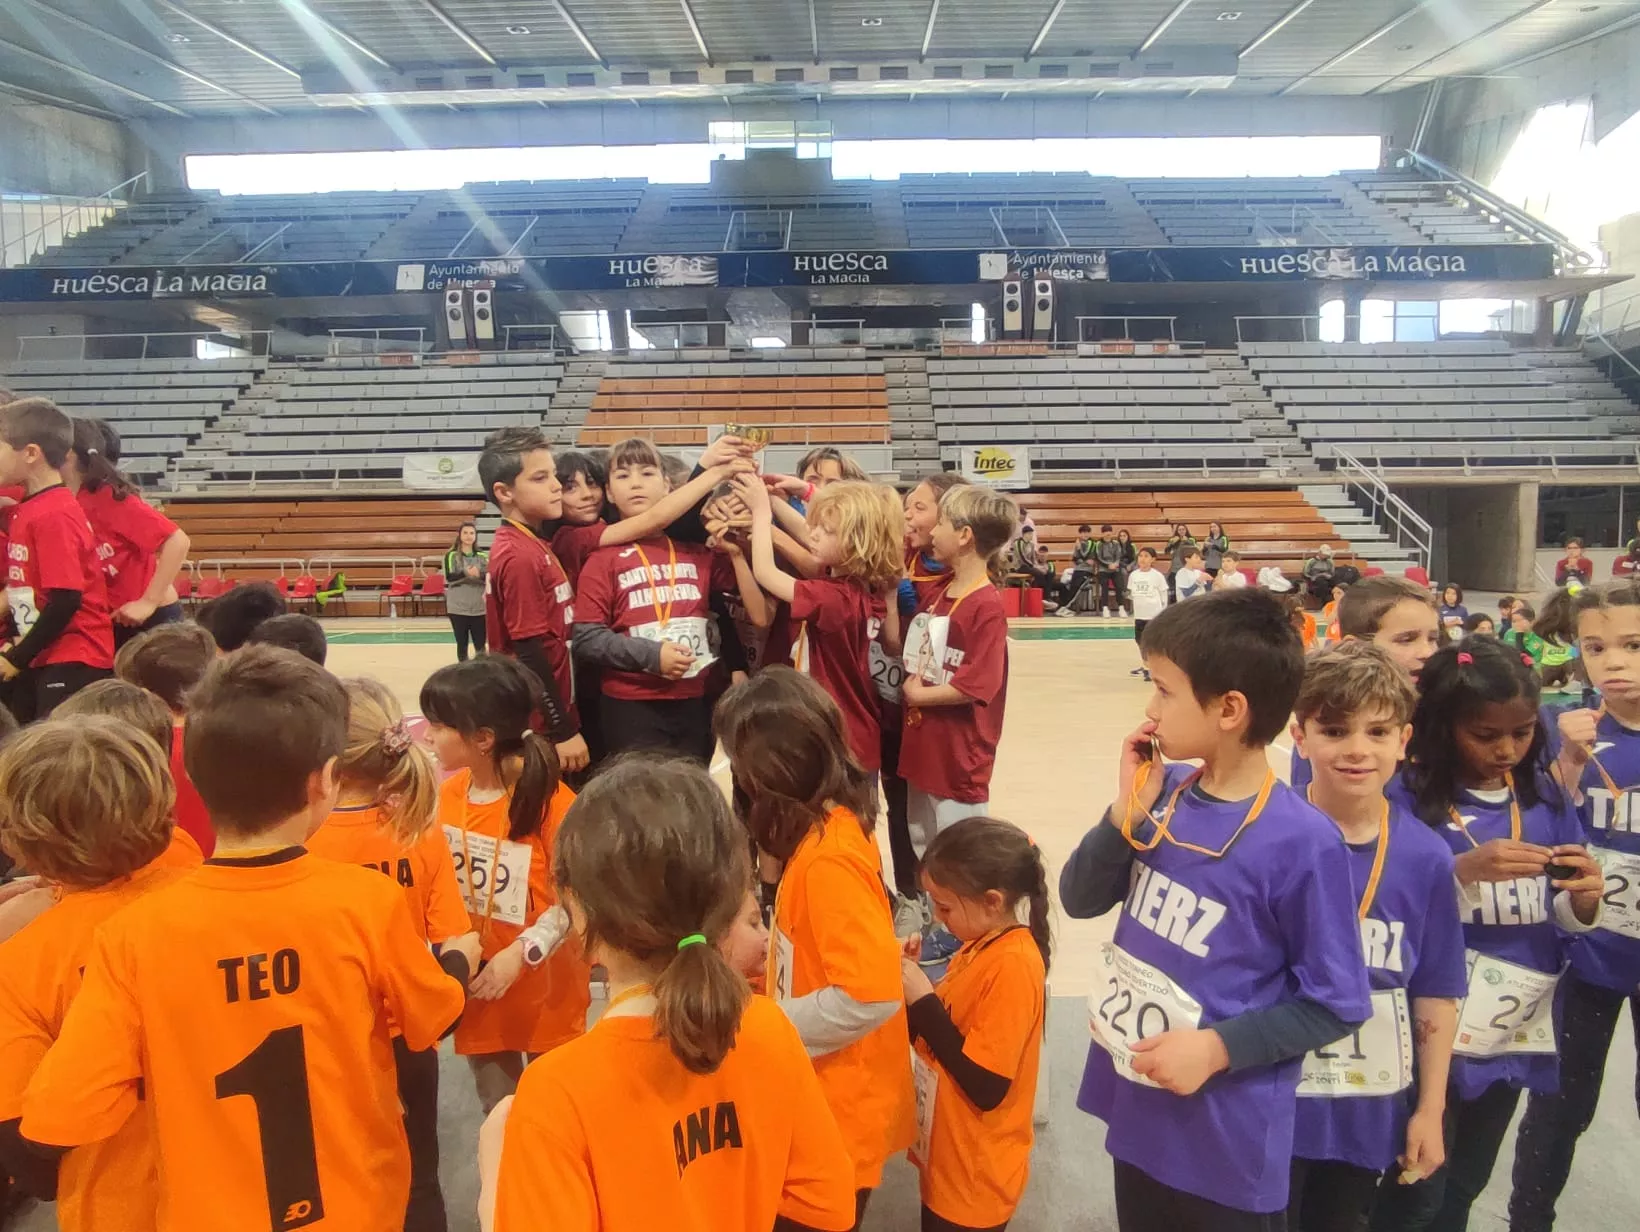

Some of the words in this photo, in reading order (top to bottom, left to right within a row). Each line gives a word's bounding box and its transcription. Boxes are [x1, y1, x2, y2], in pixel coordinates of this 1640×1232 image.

[427, 279, 443, 290] de
[429, 264, 520, 278] Ayuntamiento
[1013, 252, 1106, 267] Ayuntamiento
[216, 948, 300, 1004] TEO
[1099, 976, 1169, 1041] 220
[214, 1023, 325, 1232] 1
[672, 1100, 743, 1181] ANA
